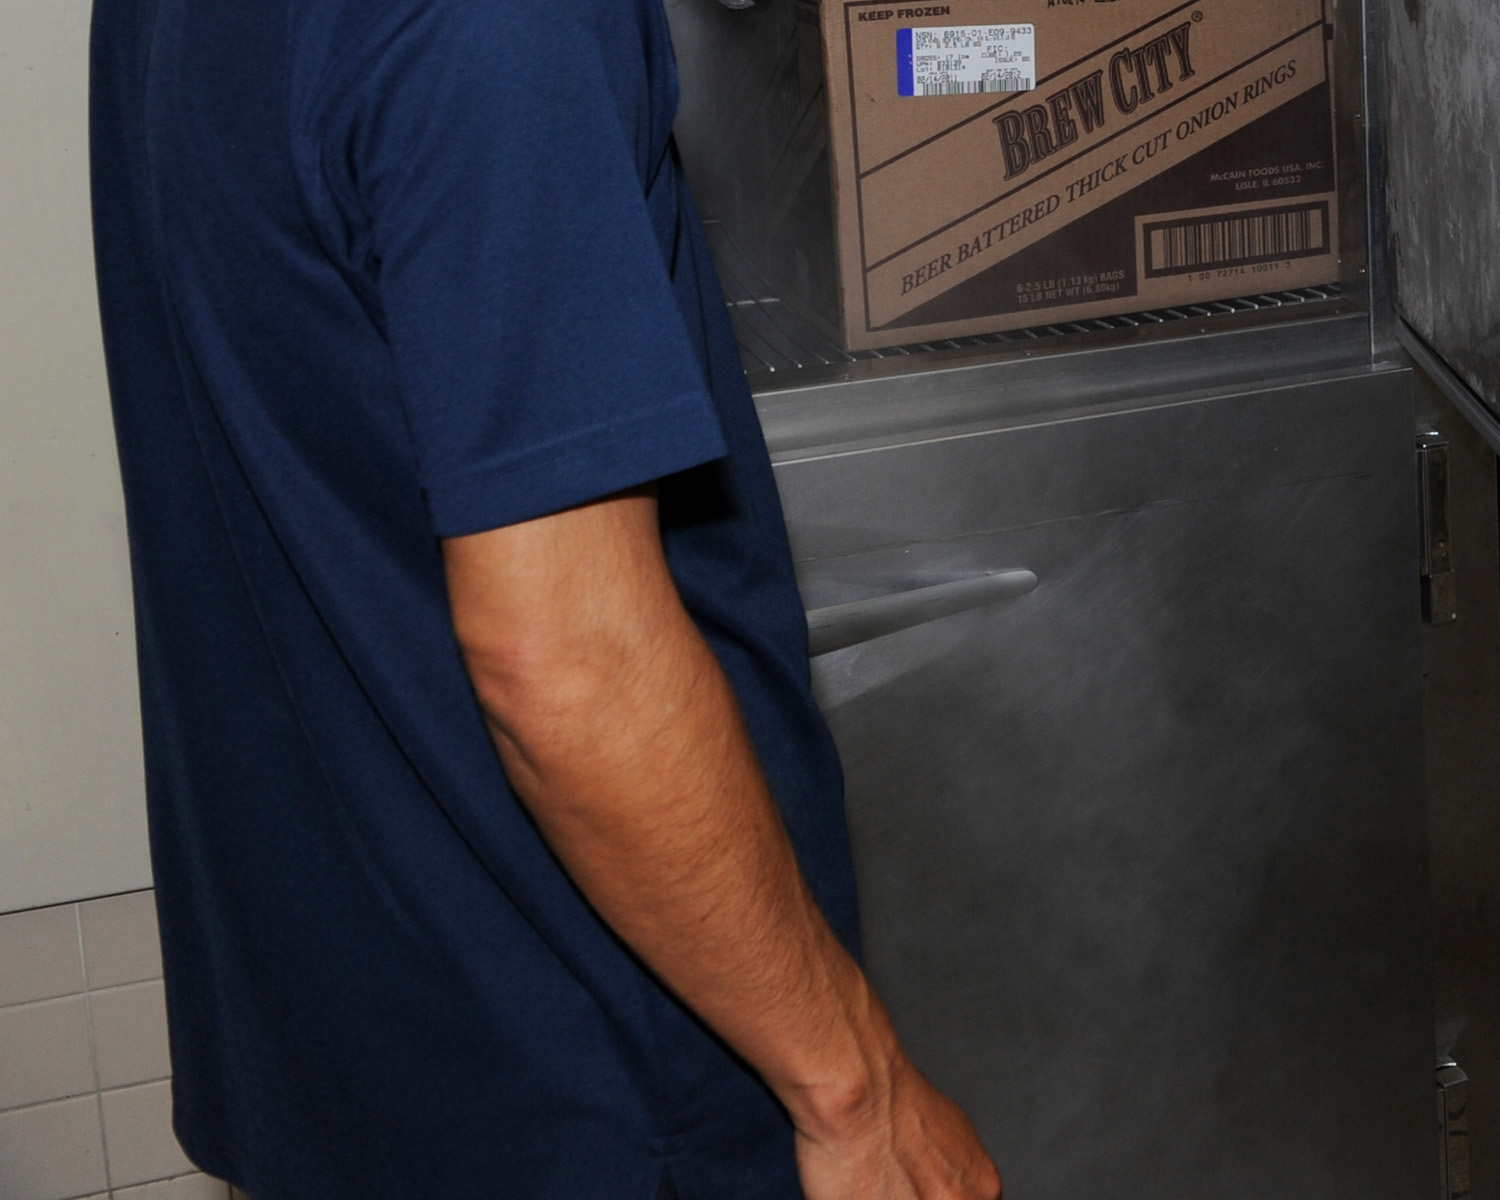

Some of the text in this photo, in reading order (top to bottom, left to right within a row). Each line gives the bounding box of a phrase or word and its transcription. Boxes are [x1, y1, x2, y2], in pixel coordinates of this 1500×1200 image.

[857, 5, 950, 22] KEEP FROZEN
[992, 68, 1105, 182] BREW
[901, 59, 1297, 296] BEER BATTERED THICK CUT ONION RINGS
[1210, 169, 1246, 182] McCAIN
[1249, 166, 1280, 177] FOODS
[1305, 161, 1325, 170] INC.
[1262, 178, 1270, 188] IL
[1272, 175, 1302, 186] 60532
[1043, 280, 1056, 290] LB
[1100, 270, 1125, 282] BAGS
[1018, 295, 1029, 304] 15
[1030, 292, 1043, 302] LB
[1045, 289, 1062, 300] NET
[1065, 286, 1081, 297] WT
